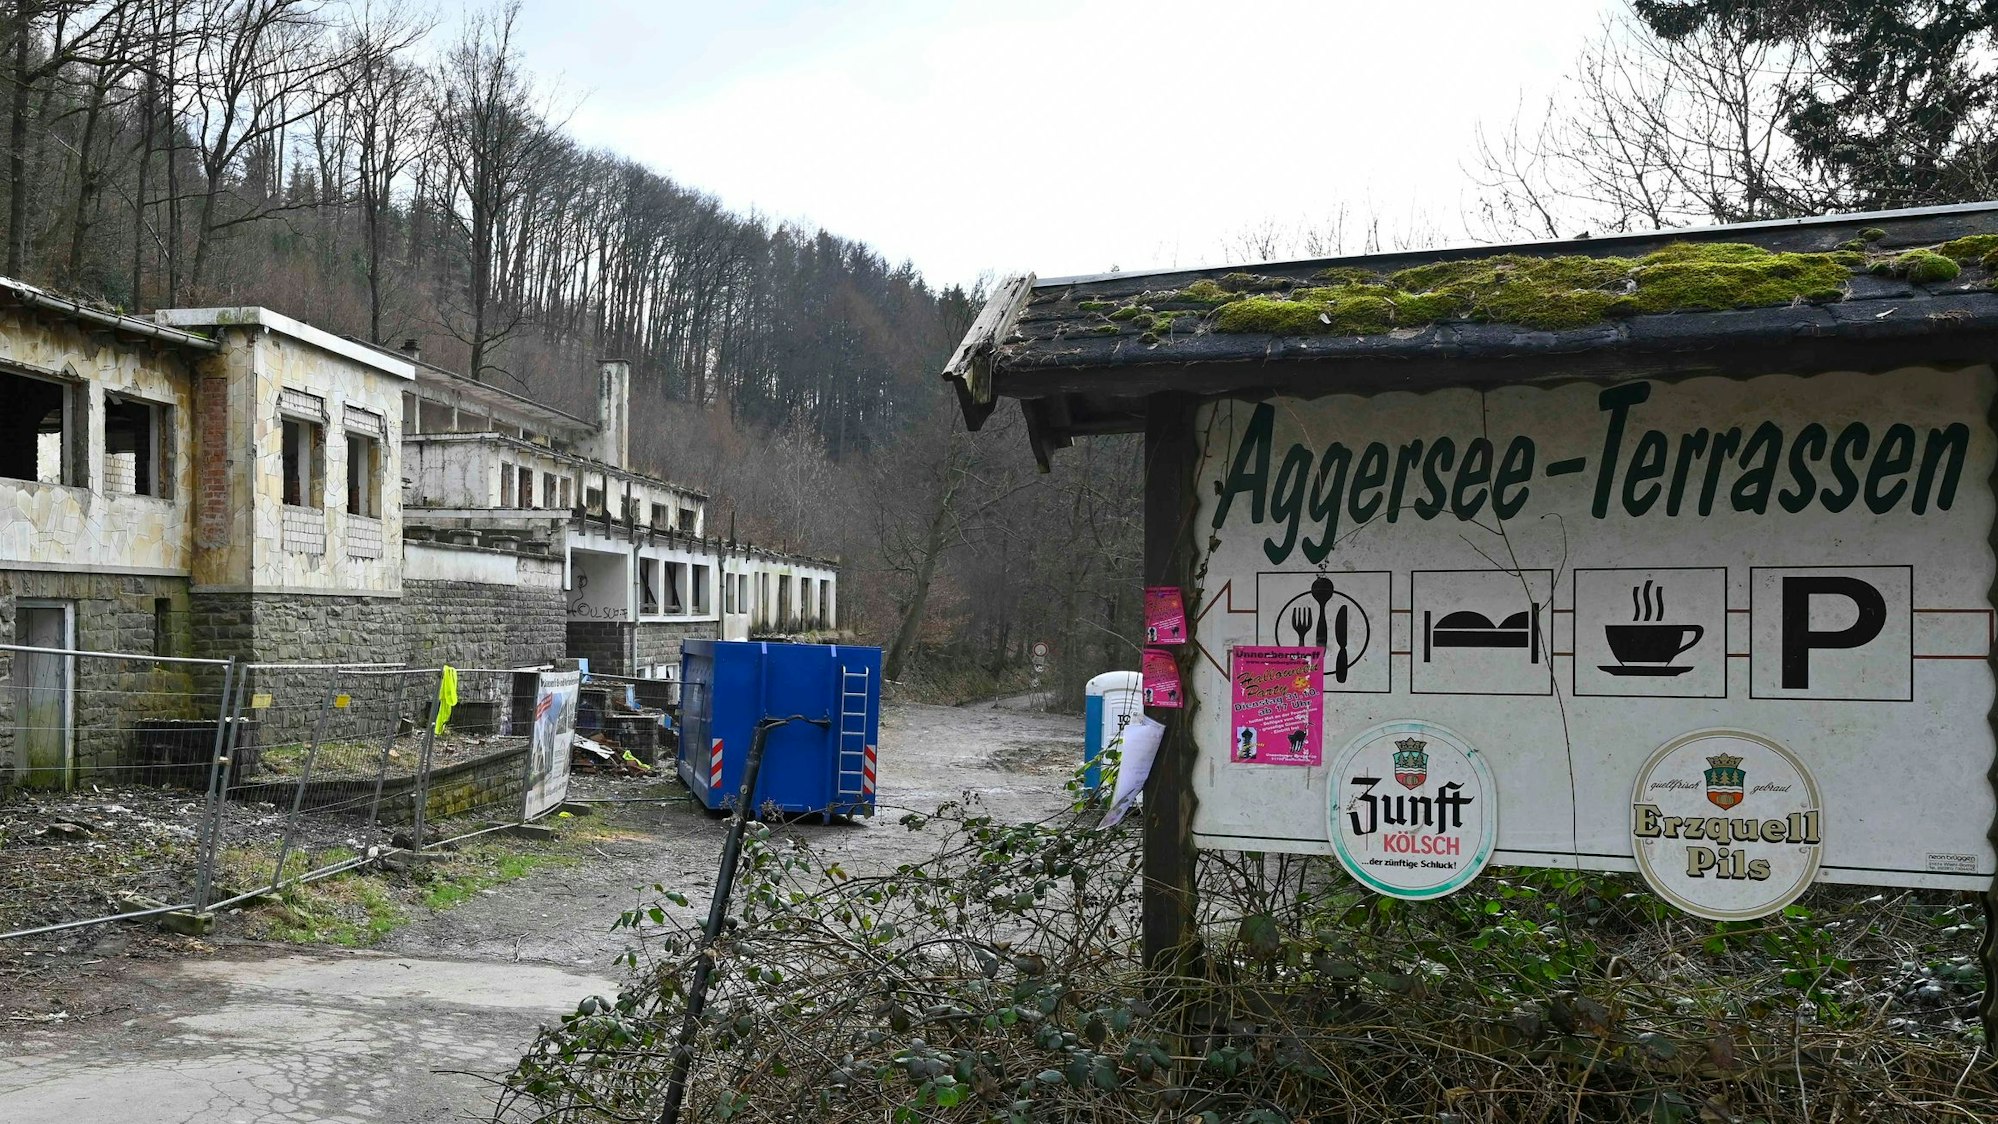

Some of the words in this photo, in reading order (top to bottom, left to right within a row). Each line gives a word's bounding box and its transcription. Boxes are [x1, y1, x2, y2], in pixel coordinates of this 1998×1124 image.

[1212, 381, 1970, 565] Aggersee-Terrassen
[1782, 576, 1887, 689] P
[1236, 651, 1320, 660] Unnenbergtreff
[1237, 664, 1319, 685] Halloween
[1246, 684, 1289, 698] Party
[1234, 696, 1283, 711] Dienstag
[1258, 706, 1272, 716] ab
[1275, 703, 1287, 712] 17
[1292, 700, 1311, 710] Uhr
[1650, 779, 1702, 792] quellfrisch
[1750, 781, 1792, 795] gebraut
[1346, 777, 1475, 837] Zunft
[1633, 803, 1821, 846] Erzquell
[1383, 831, 1460, 856] KÖLSCH
[1384, 858, 1418, 869] zünftige
[1421, 860, 1457, 870] Schluck!
[1686, 846, 1771, 881] Pils
